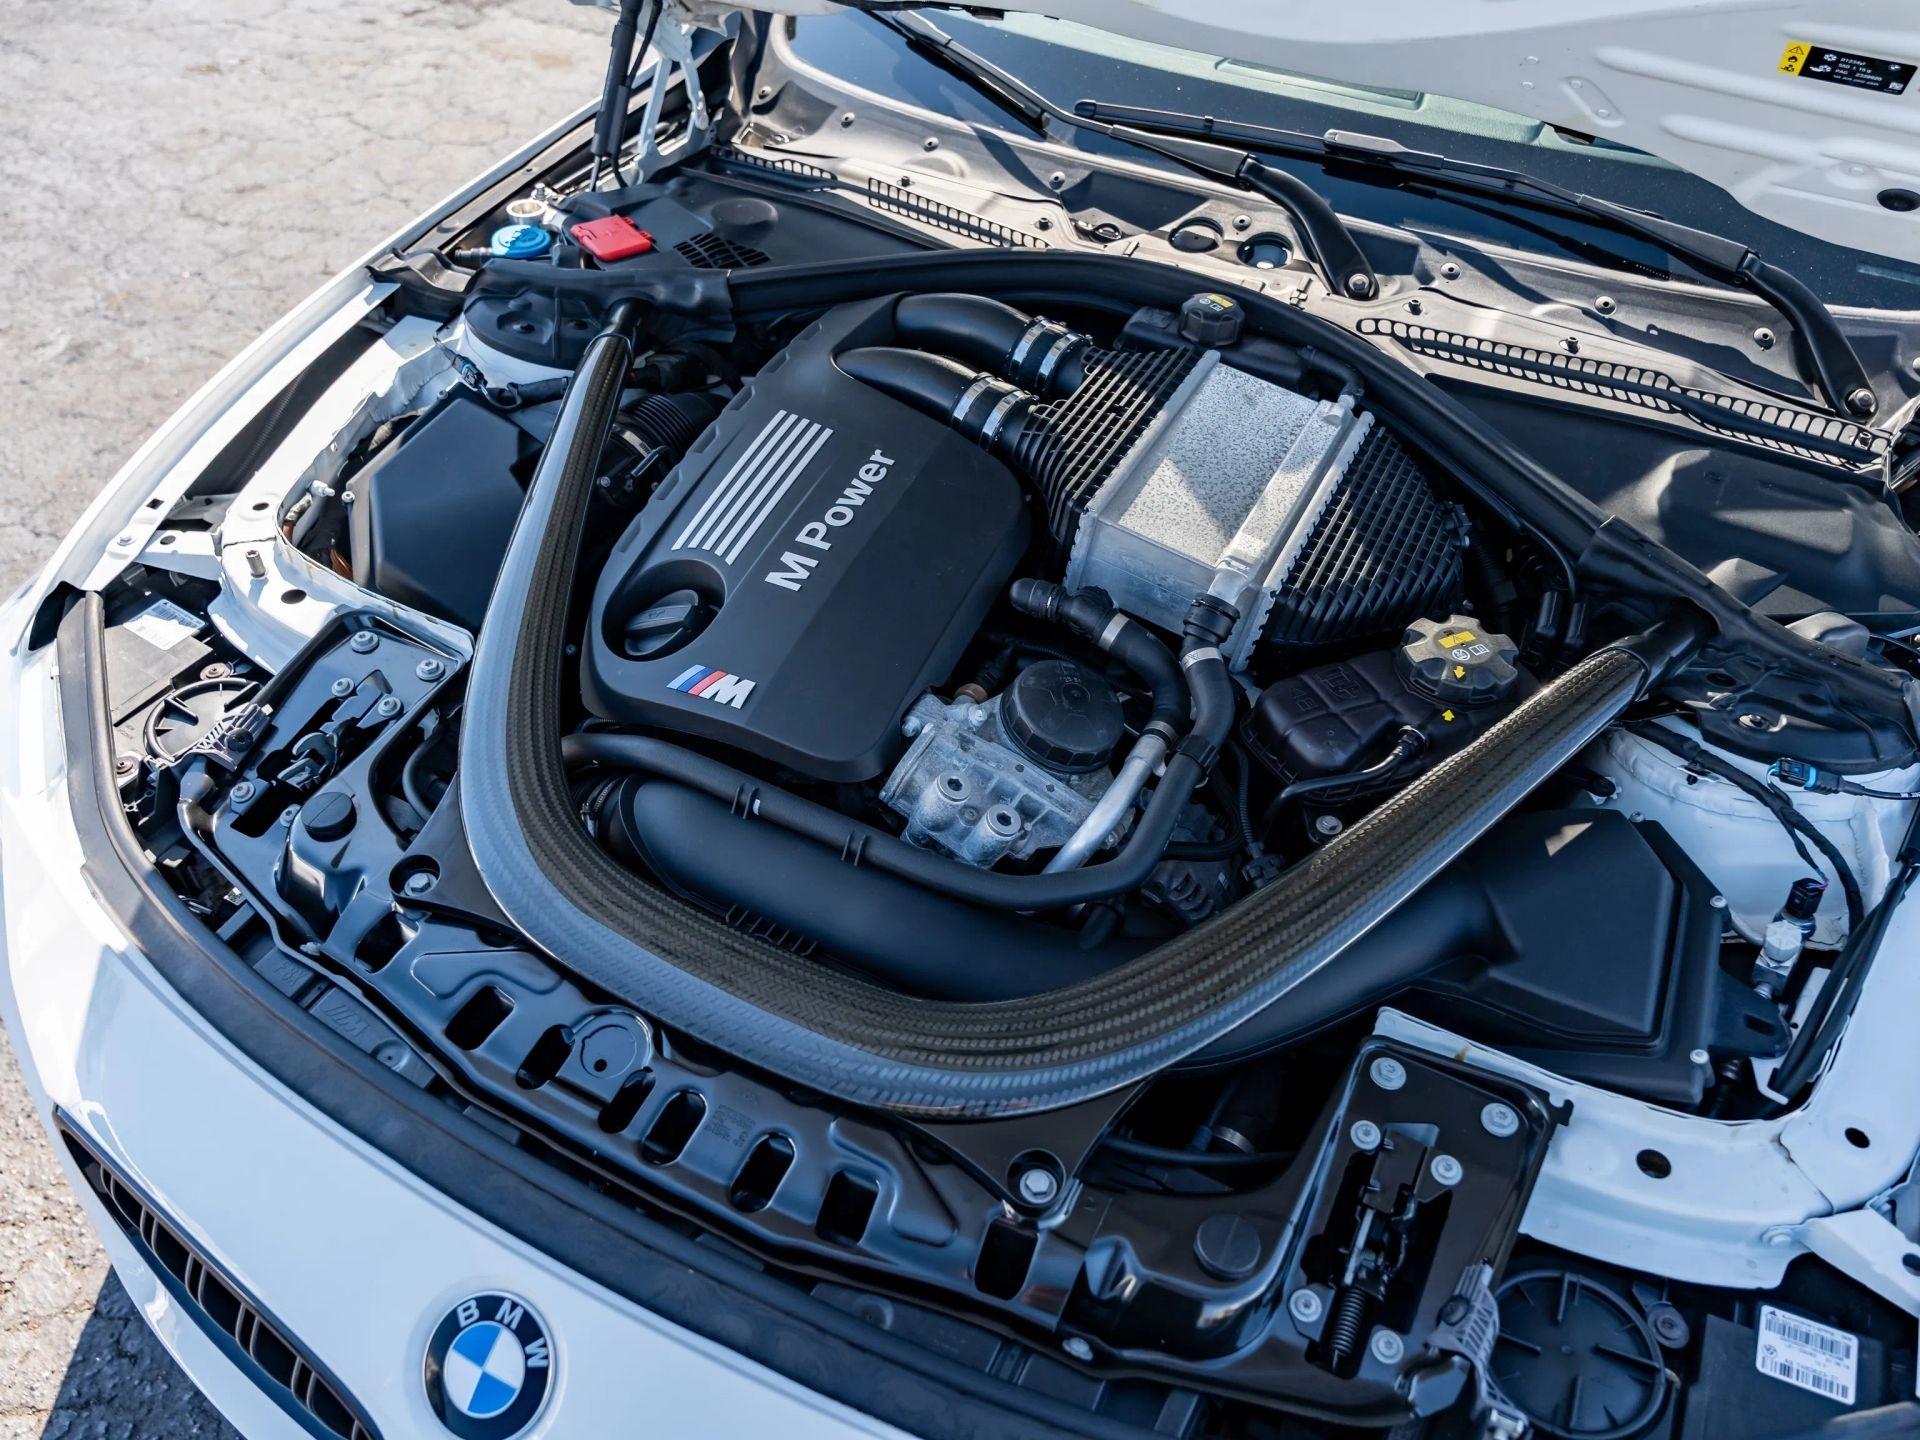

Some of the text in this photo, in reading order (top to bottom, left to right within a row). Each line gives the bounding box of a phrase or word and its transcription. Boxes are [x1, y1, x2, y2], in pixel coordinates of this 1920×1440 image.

[764, 449, 895, 592] M Power
[456, 1298, 549, 1368] BMW
